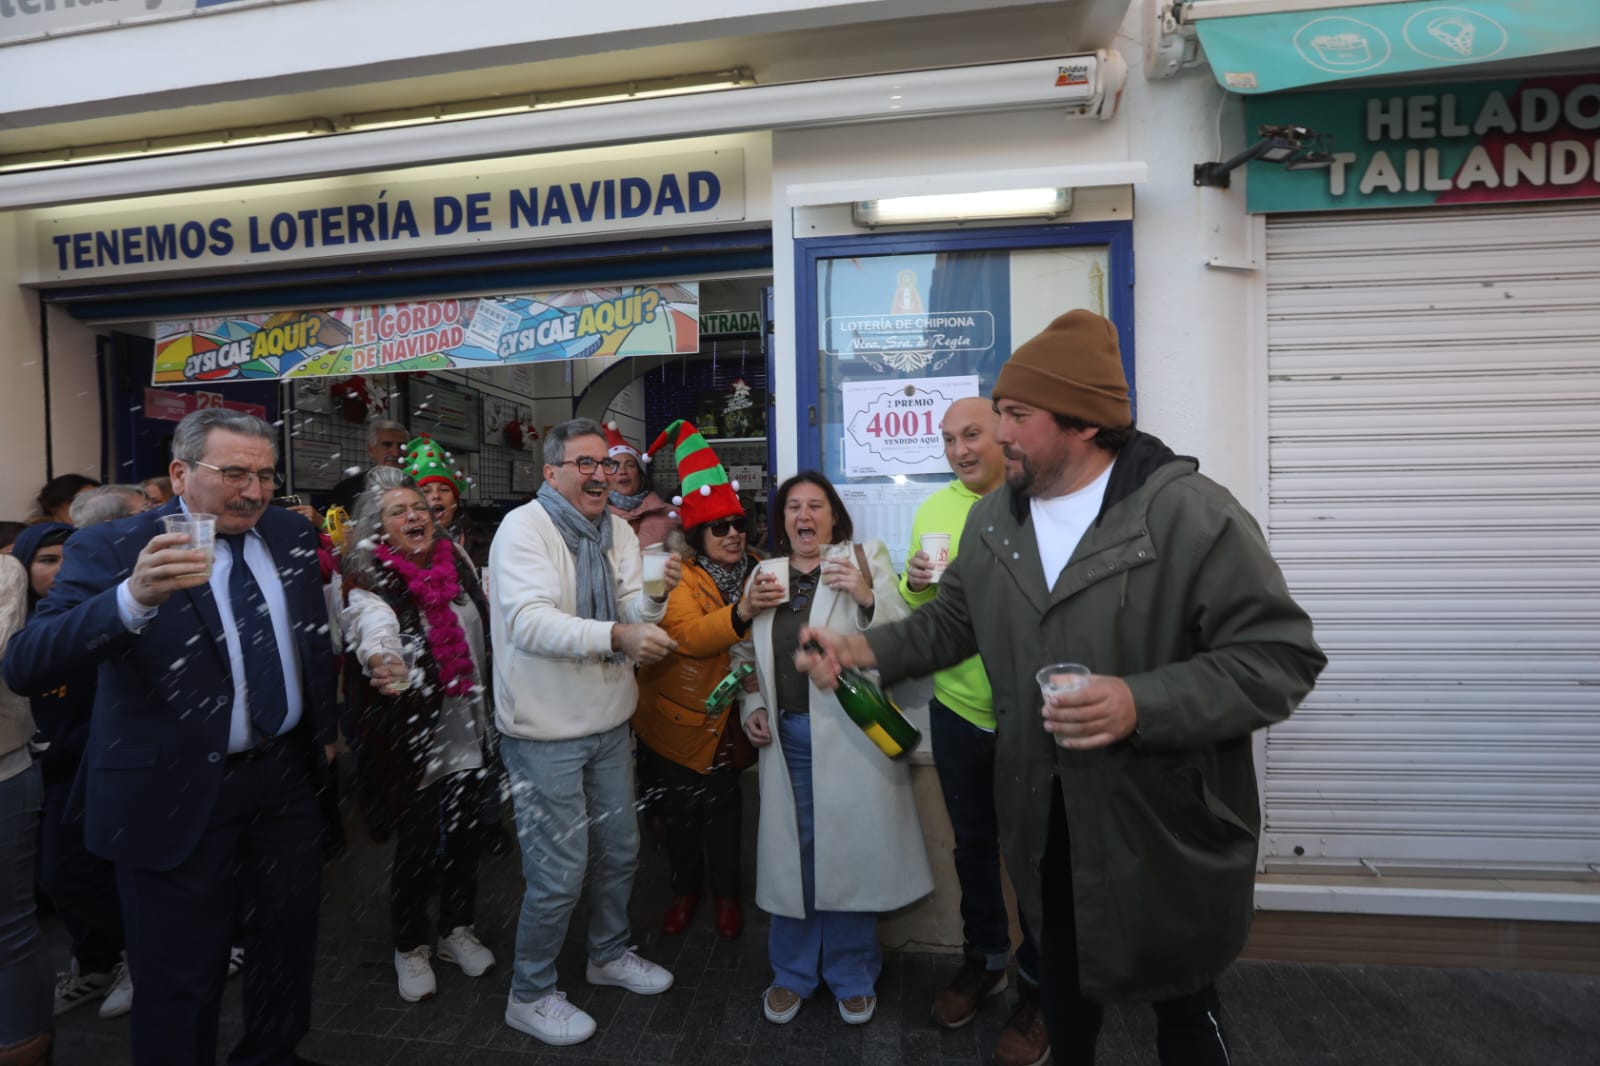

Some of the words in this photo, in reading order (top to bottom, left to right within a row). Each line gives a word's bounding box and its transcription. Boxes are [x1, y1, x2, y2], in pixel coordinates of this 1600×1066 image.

[1366, 83, 1600, 142] HELADO
[53, 218, 234, 271] TENEMOS
[248, 190, 420, 253] LOTERÍA
[434, 192, 492, 236] DE
[509, 170, 721, 229] NAVIDAD
[353, 319, 377, 346] EL
[380, 298, 460, 340] GORDO
[537, 314, 576, 346] CAE
[576, 287, 660, 338] AQUÍ?
[840, 318, 893, 332] LOTERÍA
[895, 319, 913, 330] DE
[915, 316, 975, 329] CHIPIONA
[218, 339, 251, 367] CAE
[251, 313, 321, 360] AQUÍ?
[353, 346, 377, 370] DE
[381, 325, 463, 364] NAVIDAD
[930, 333, 971, 350] Regla
[866, 410, 943, 438] 4001
[894, 398, 934, 408] PREMIO
[884, 438, 919, 446] VENDIDO
